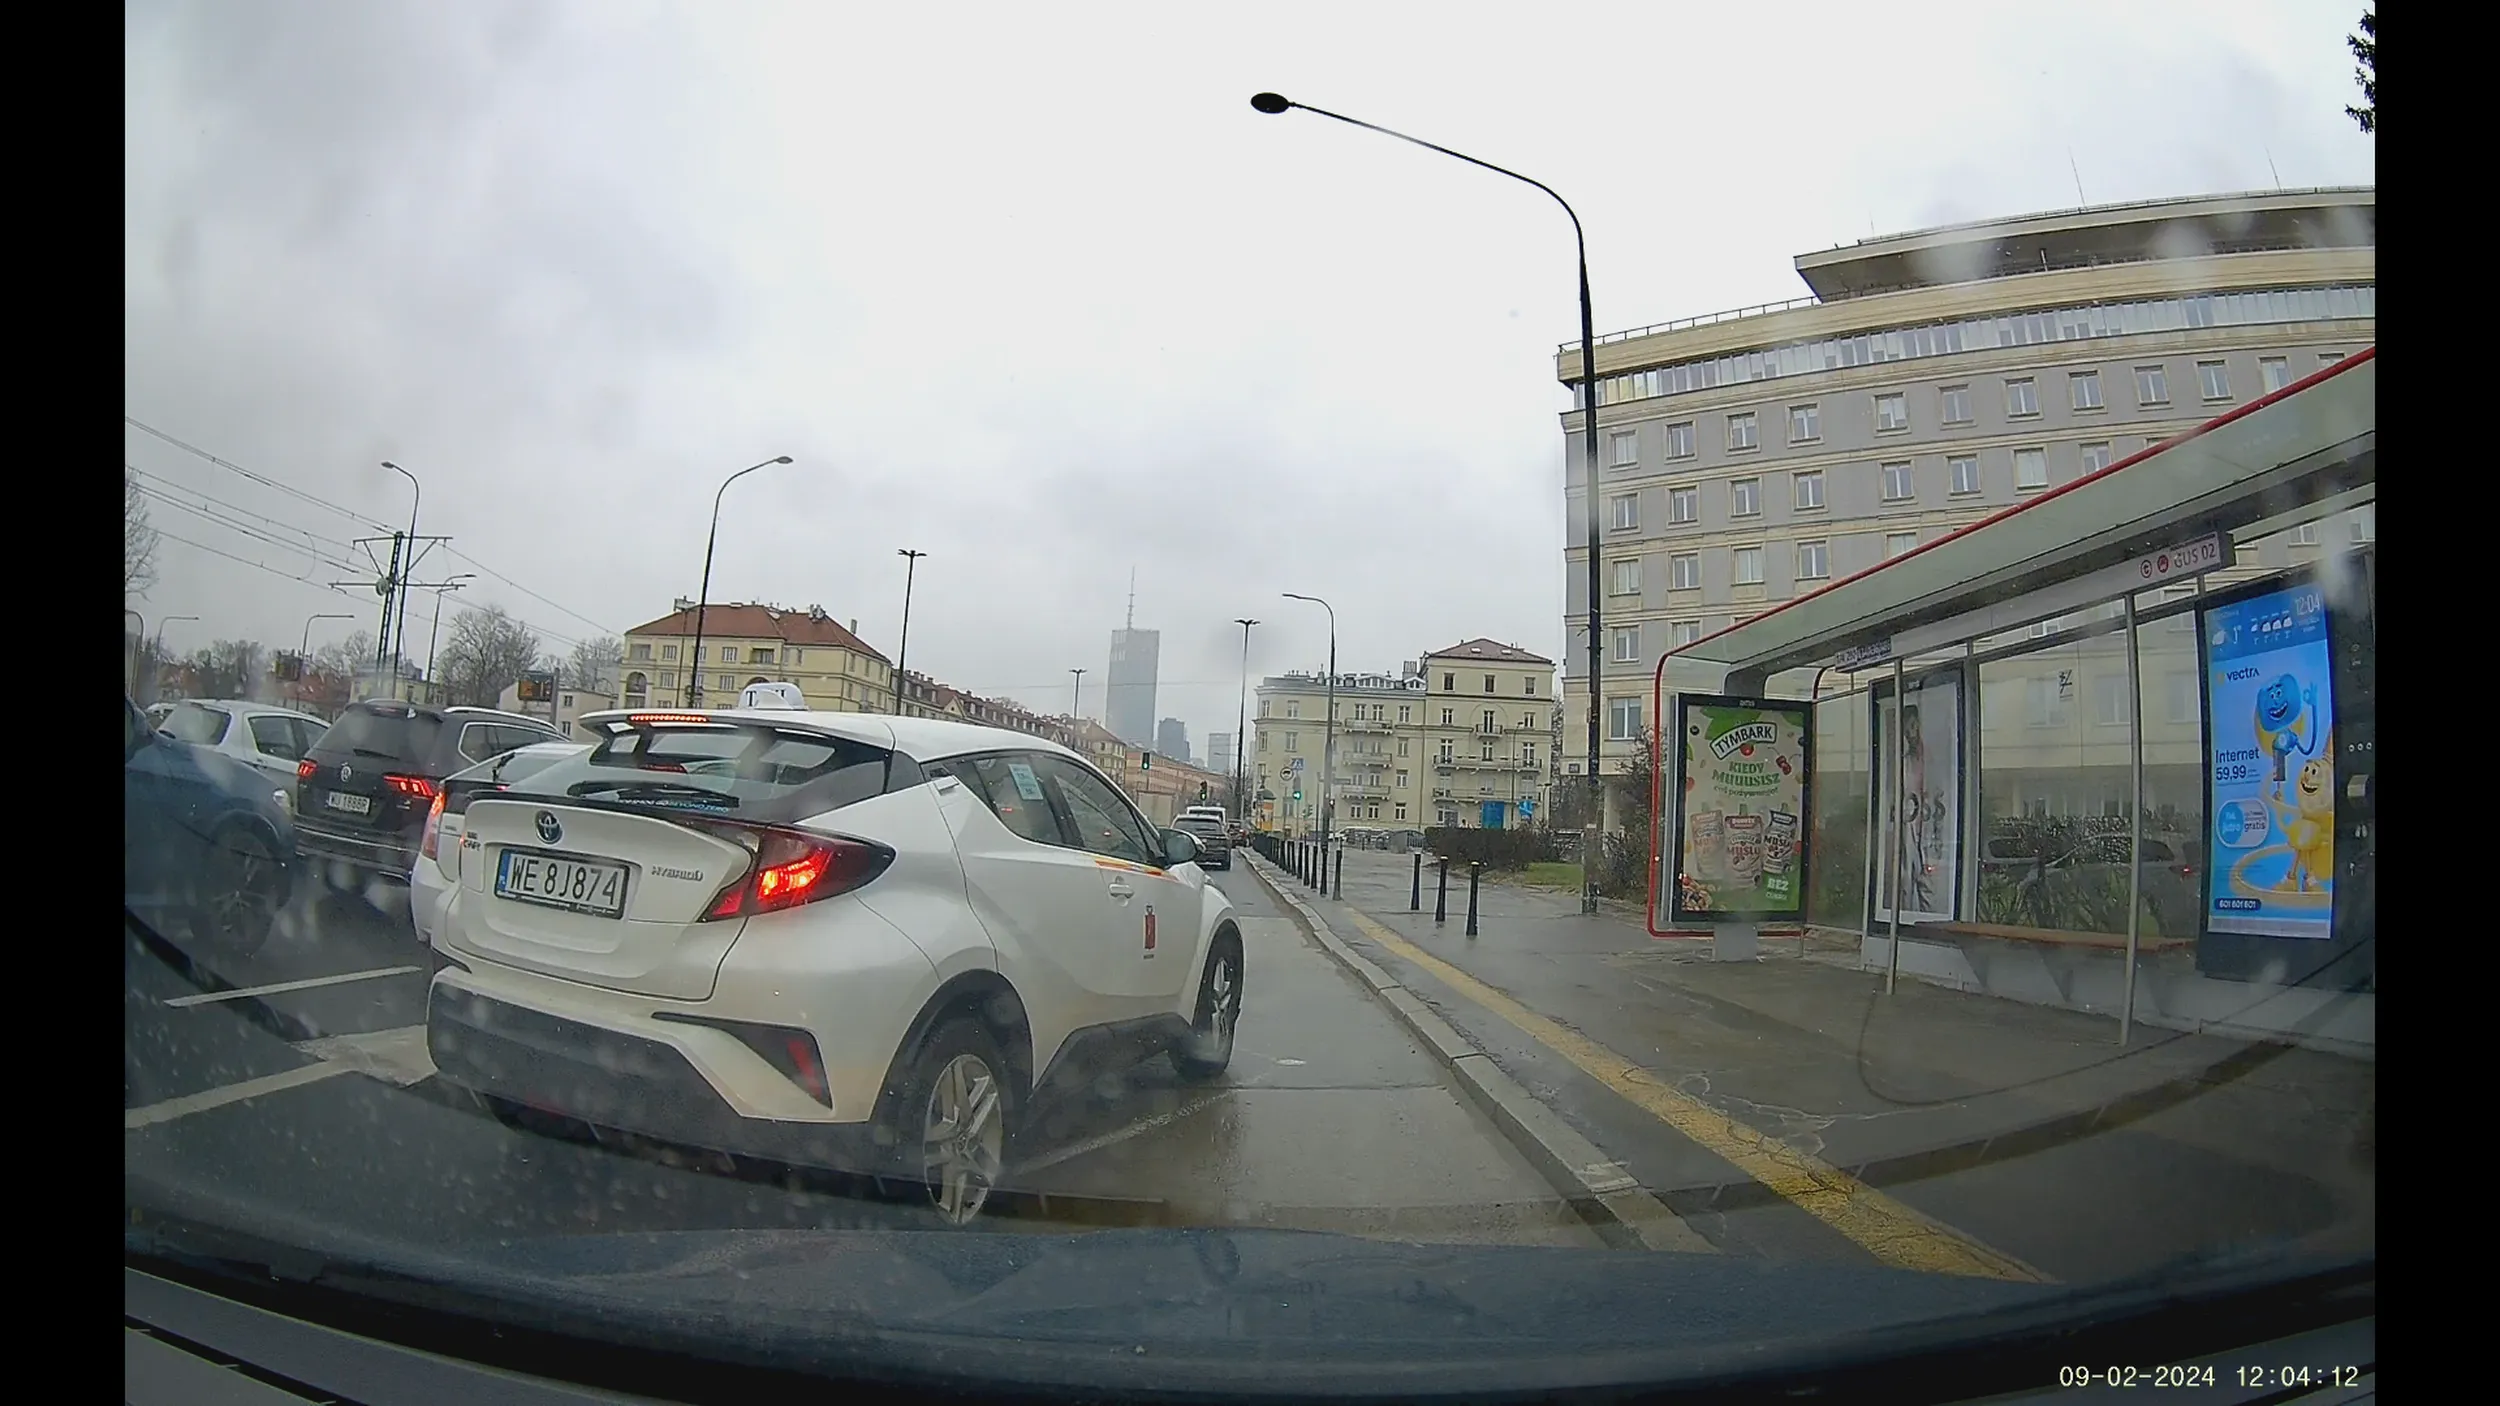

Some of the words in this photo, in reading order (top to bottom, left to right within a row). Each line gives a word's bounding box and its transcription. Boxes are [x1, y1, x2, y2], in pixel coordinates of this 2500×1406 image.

[2174, 548, 2198, 568] GUS
[2201, 543, 2215, 560] 02
[2296, 593, 2320, 615] 12:04
[1715, 725, 1773, 753] TYMBARK
[2215, 747, 2260, 763] Internet
[1728, 761, 1765, 774] KIEDY
[2215, 765, 2247, 781] 59,99
[2244, 821, 2266, 832] gratis
[510, 857, 539, 892] WE
[544, 863, 619, 906] 8J874
[1767, 877, 1789, 891] BEZ
